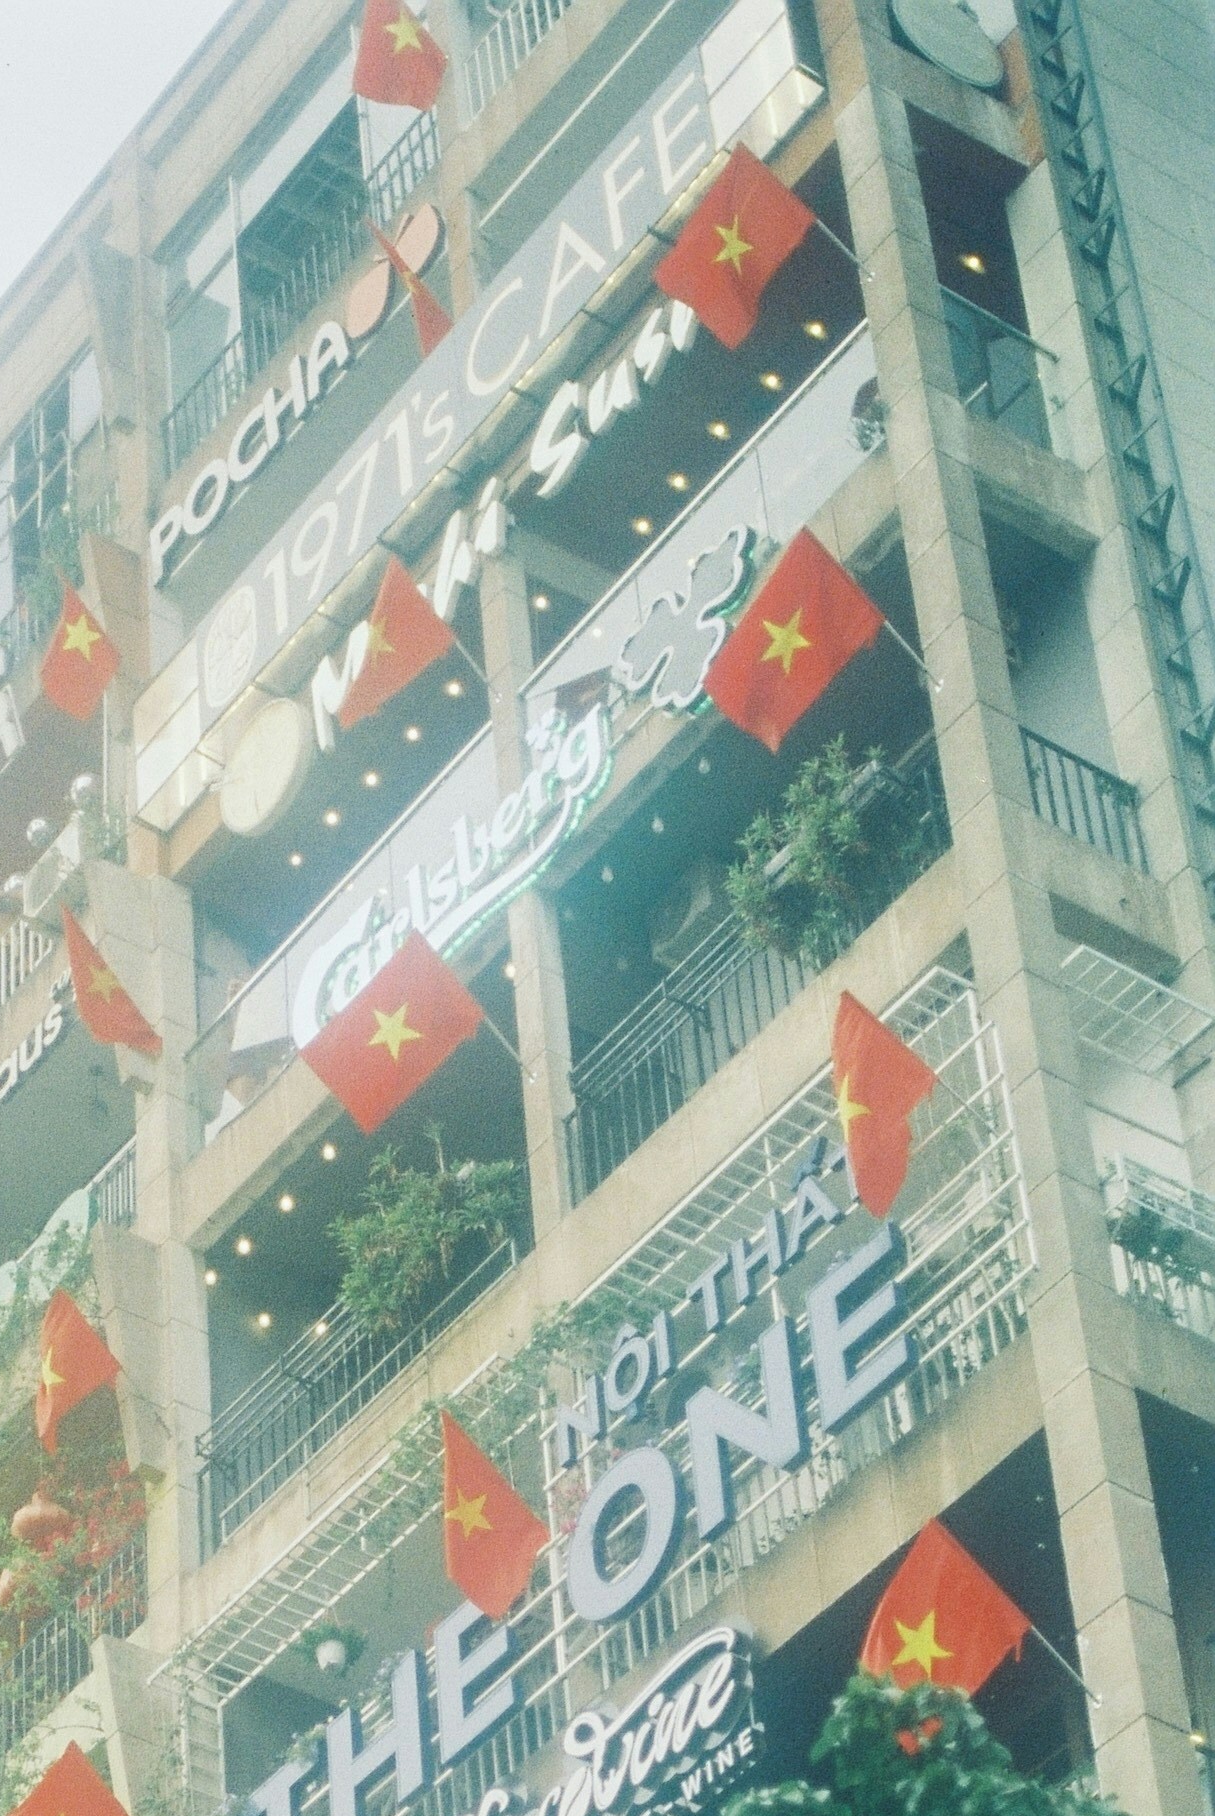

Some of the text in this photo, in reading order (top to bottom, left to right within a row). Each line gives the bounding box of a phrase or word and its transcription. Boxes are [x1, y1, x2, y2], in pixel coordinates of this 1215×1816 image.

[150, 321, 348, 580] POCHA
[264, 72, 709, 635] 1971's CAFE
[530, 298, 699, 497] Sus
[292, 703, 604, 1049] Carlsberg
[556, 1310, 672, 1466] NỘI
[567, 1222, 909, 1621] ONE
[682, 1729, 754, 1800] WINE
